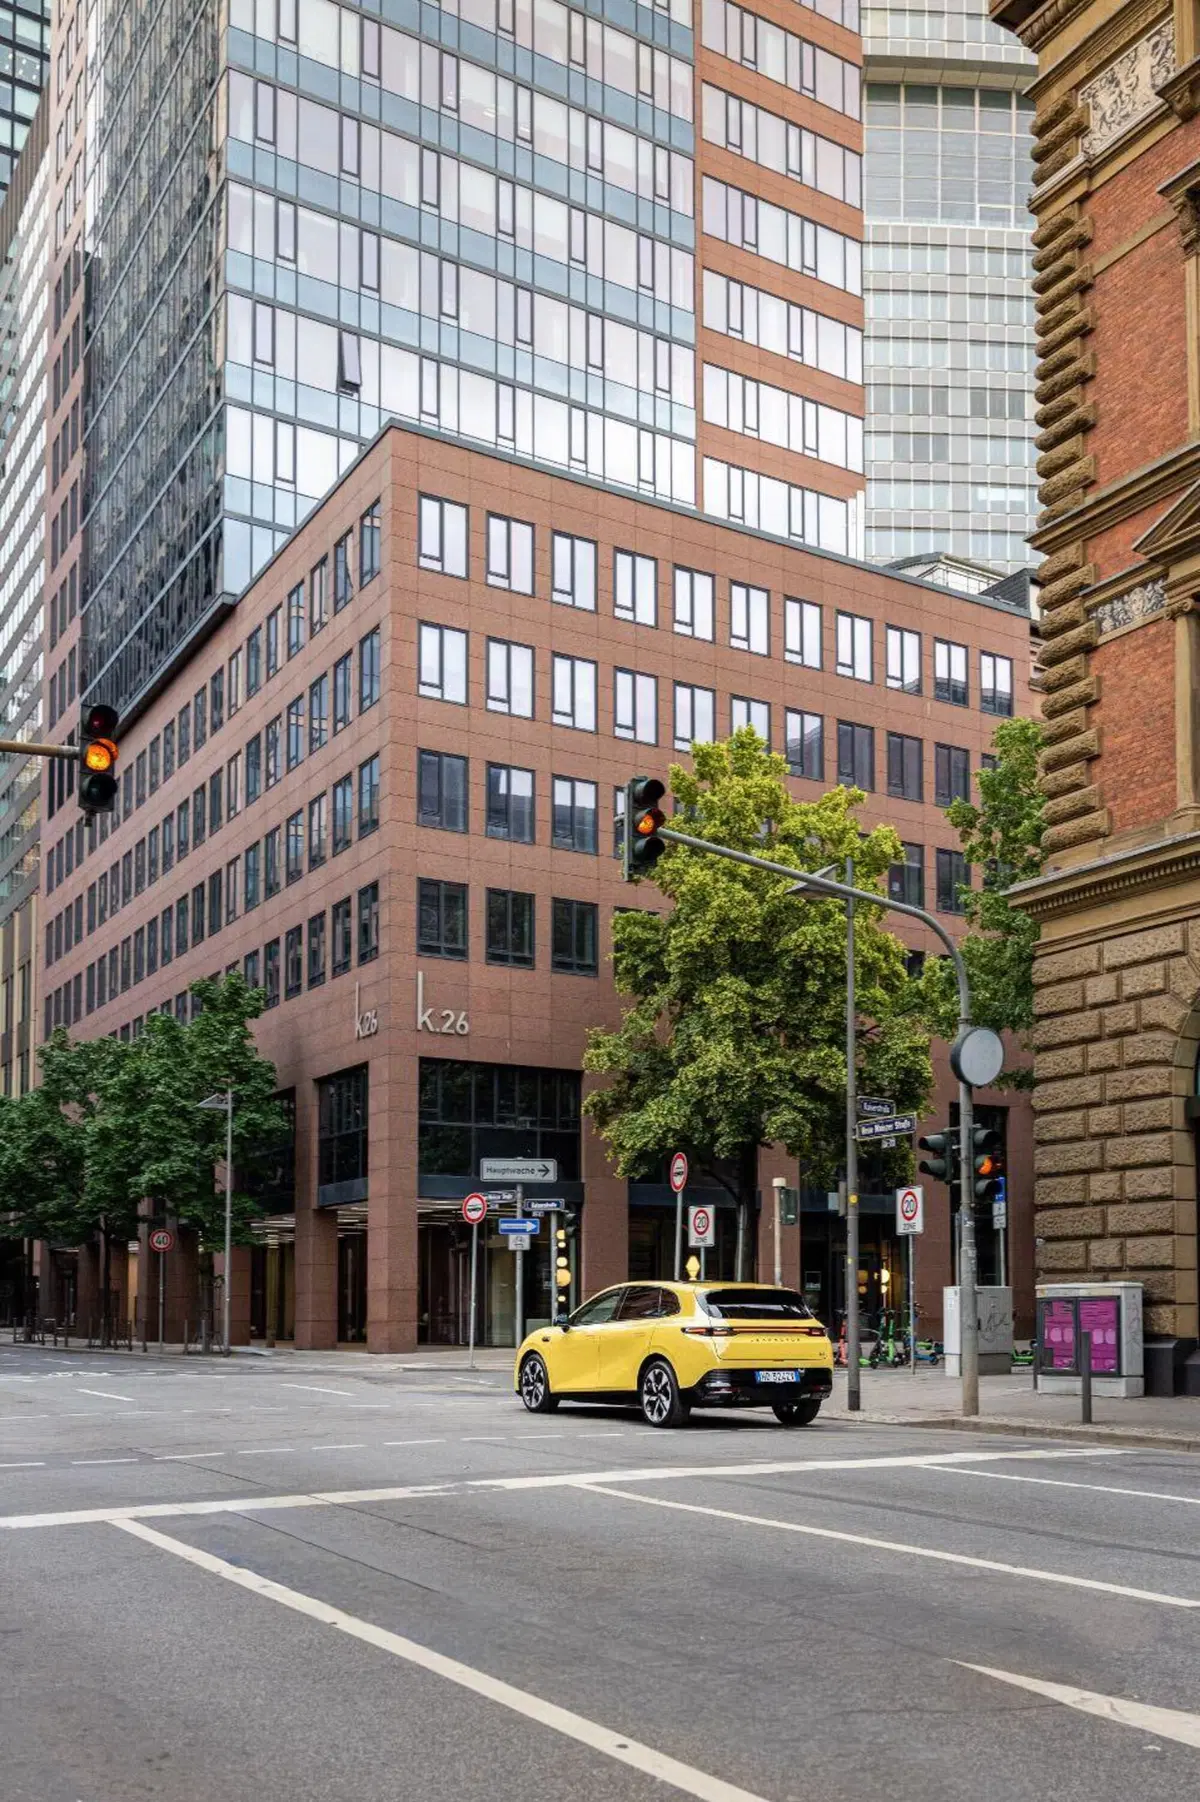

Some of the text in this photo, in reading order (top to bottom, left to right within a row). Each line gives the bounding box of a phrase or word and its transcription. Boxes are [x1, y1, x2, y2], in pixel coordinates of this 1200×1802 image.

[486, 1165, 536, 1176] Hauptwache
[904, 1199, 914, 1213] 20
[697, 1216, 706, 1228] 20
